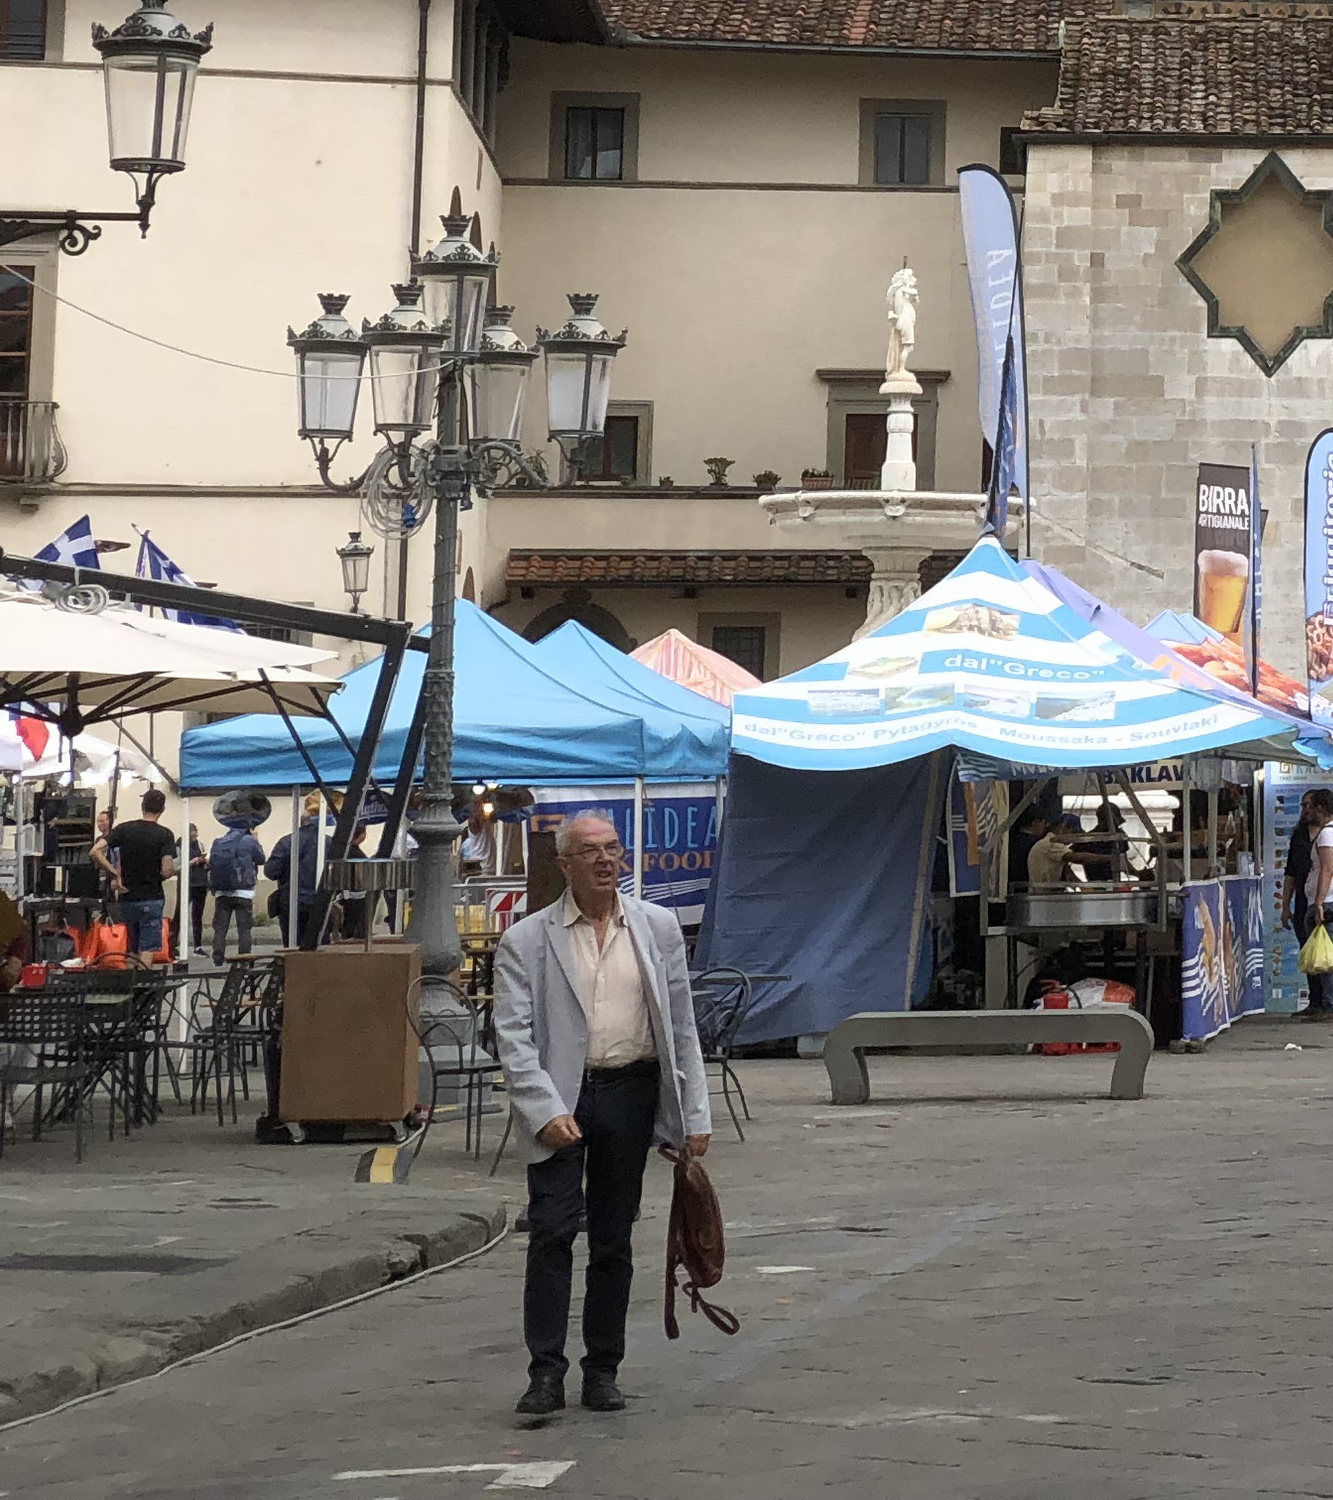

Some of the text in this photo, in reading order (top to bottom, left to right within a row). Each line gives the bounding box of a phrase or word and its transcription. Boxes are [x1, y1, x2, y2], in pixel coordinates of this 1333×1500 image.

[1199, 483, 1250, 515] BIRRA
[1198, 513, 1250, 531] ARTIGIANALE
[999, 726, 1108, 744] Moussaka
[1129, 714, 1219, 742] Souvlaki
